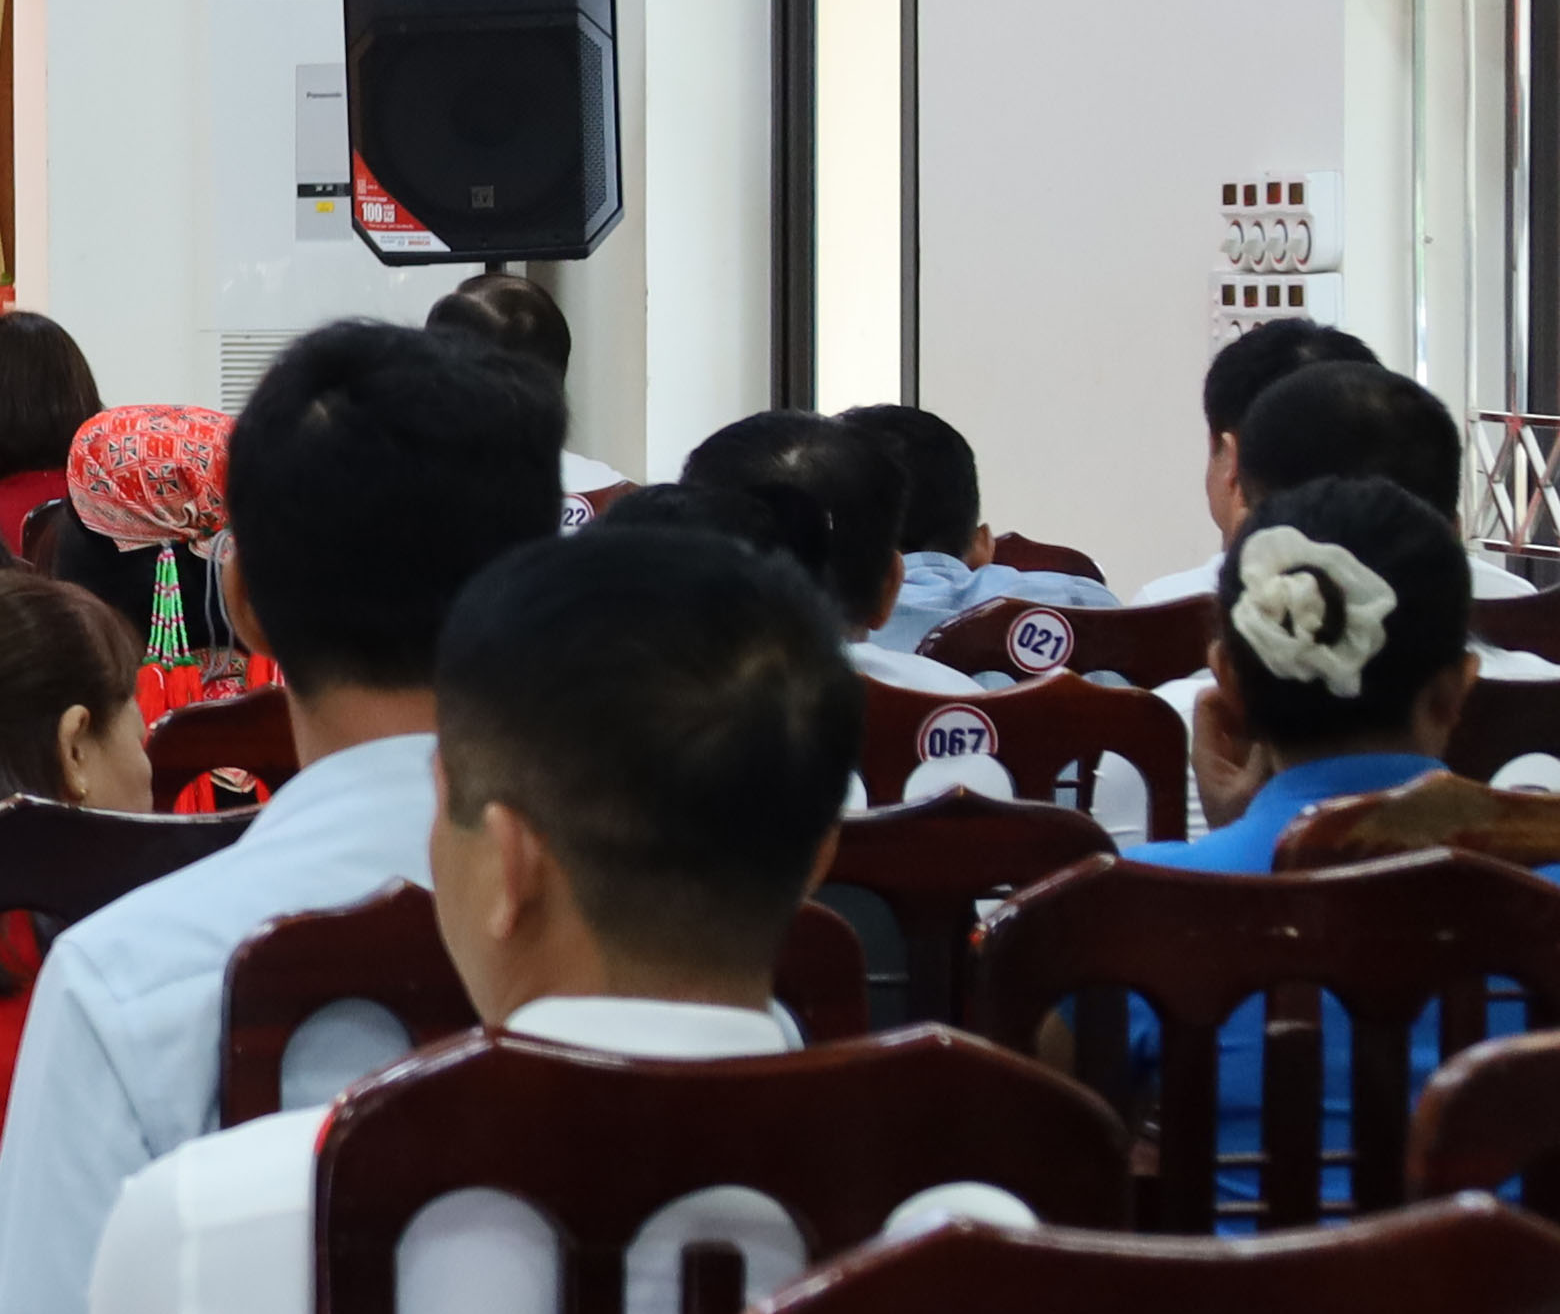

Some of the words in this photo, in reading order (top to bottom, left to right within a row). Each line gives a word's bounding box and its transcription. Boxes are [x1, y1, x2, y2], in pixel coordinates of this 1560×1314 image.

[563, 508, 586, 525] 22
[1016, 622, 1064, 661] 021
[929, 727, 987, 758] 067
